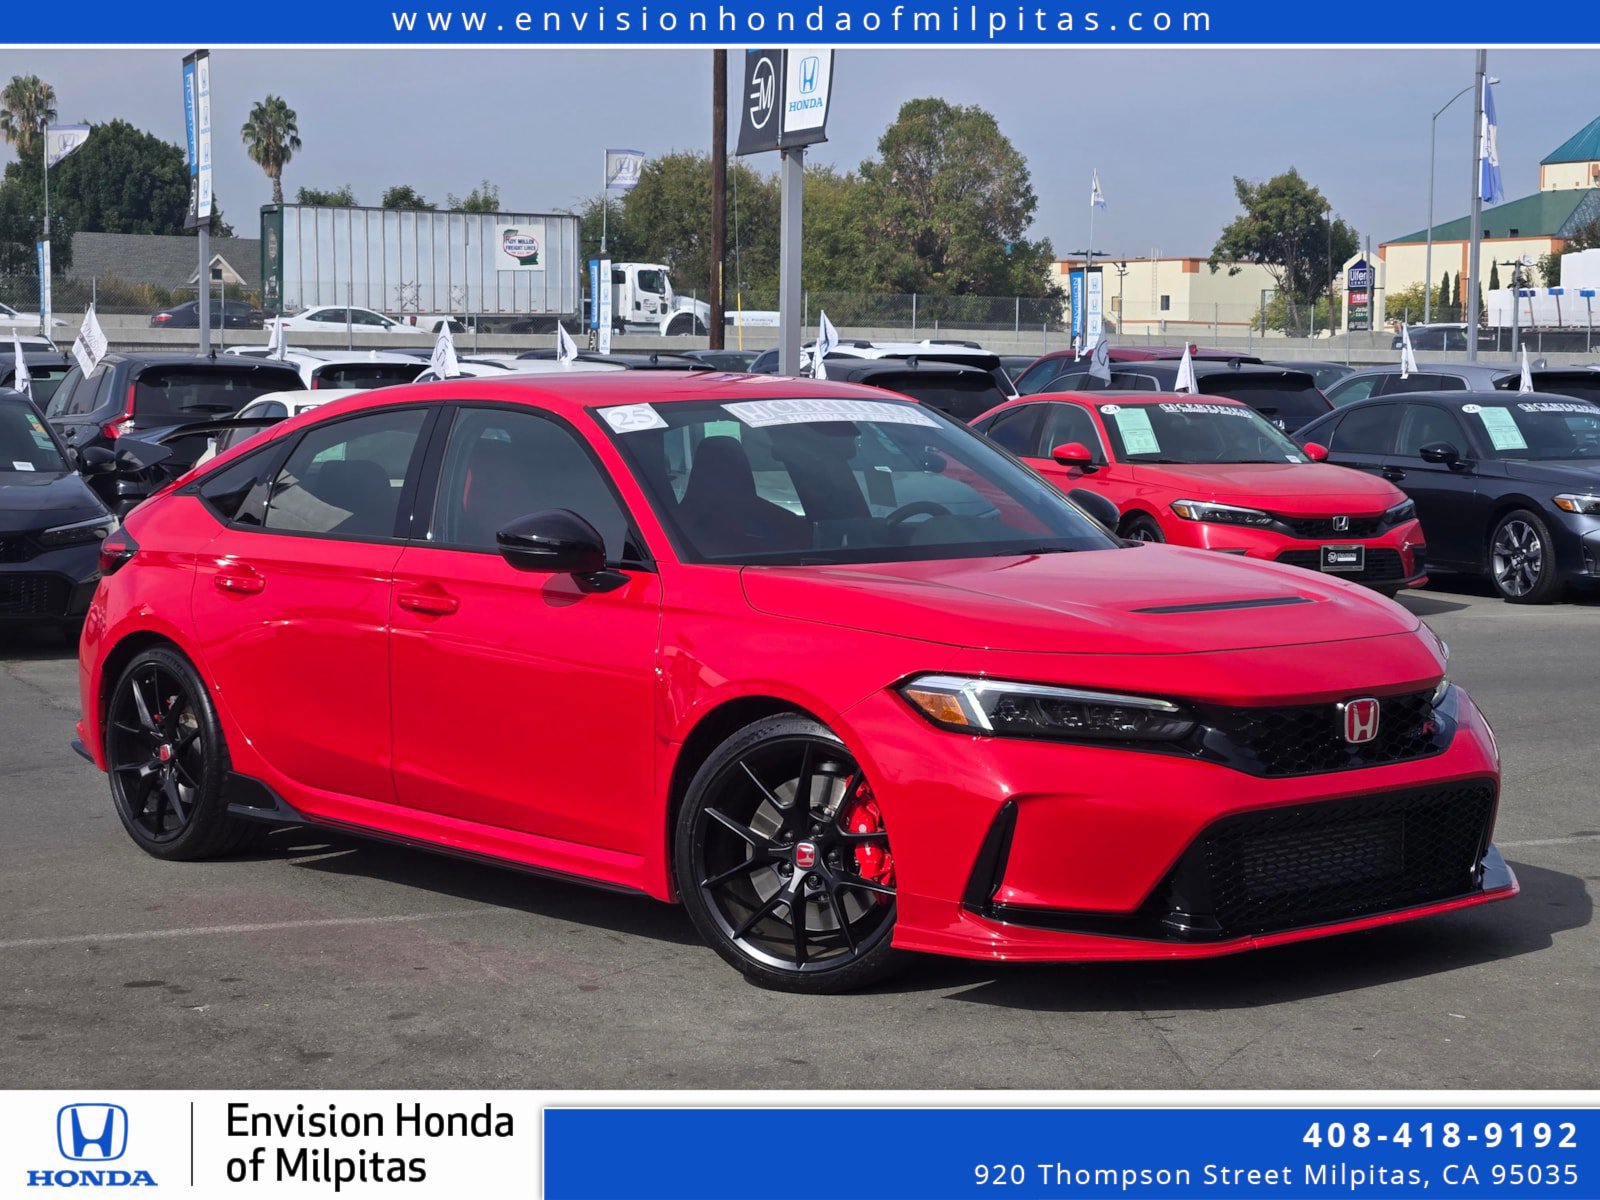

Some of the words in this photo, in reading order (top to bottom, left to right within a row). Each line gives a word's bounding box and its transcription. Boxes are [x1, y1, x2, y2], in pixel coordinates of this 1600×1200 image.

[788, 97, 823, 112] HONDA
[766, 399, 925, 417] CERTIFIED
[608, 408, 653, 426] 25
[786, 412, 845, 424] HONDA
[846, 413, 865, 422] OF
